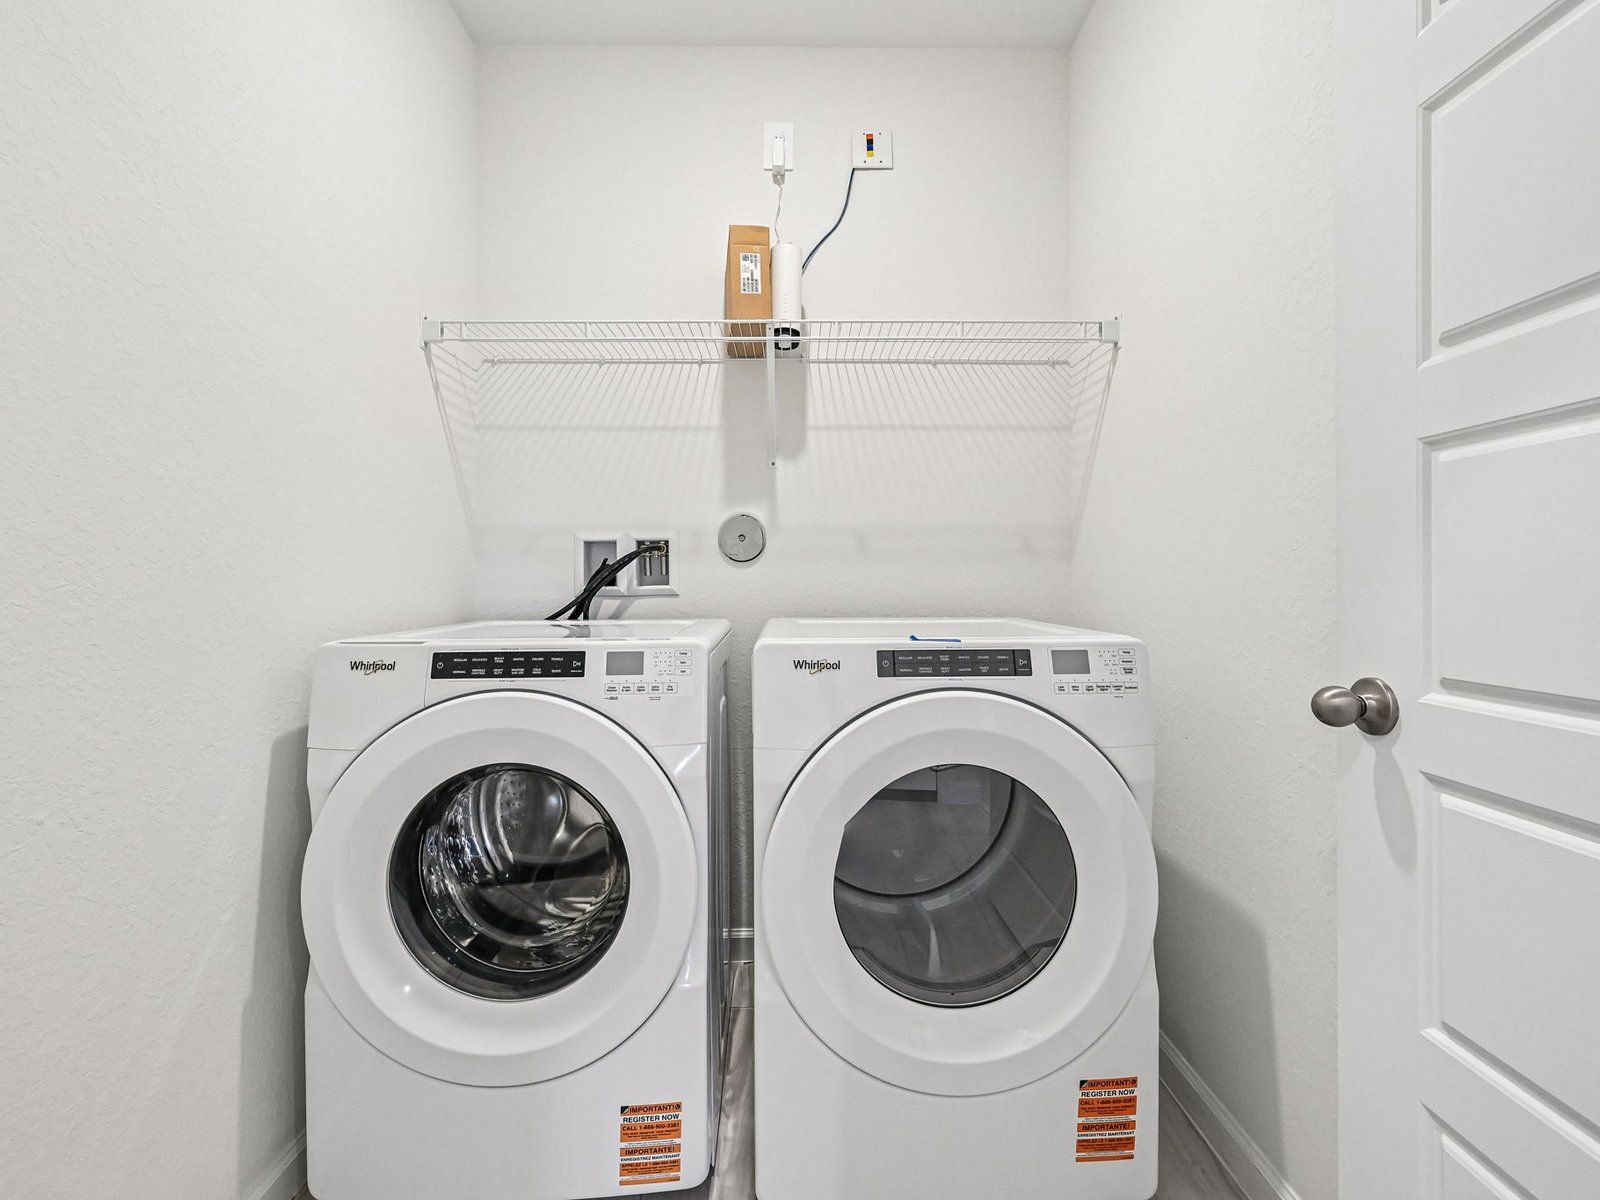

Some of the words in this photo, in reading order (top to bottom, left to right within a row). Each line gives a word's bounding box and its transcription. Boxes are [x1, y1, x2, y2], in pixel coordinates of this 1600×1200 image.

[350, 660, 396, 674] Whirlpool
[793, 659, 841, 673] Whirlpool
[1088, 1079, 1130, 1087] IMPORTANT!
[630, 1104, 674, 1113] IMPORTANT!
[622, 1115, 660, 1123] REGISTER
[661, 1113, 680, 1121] NOW
